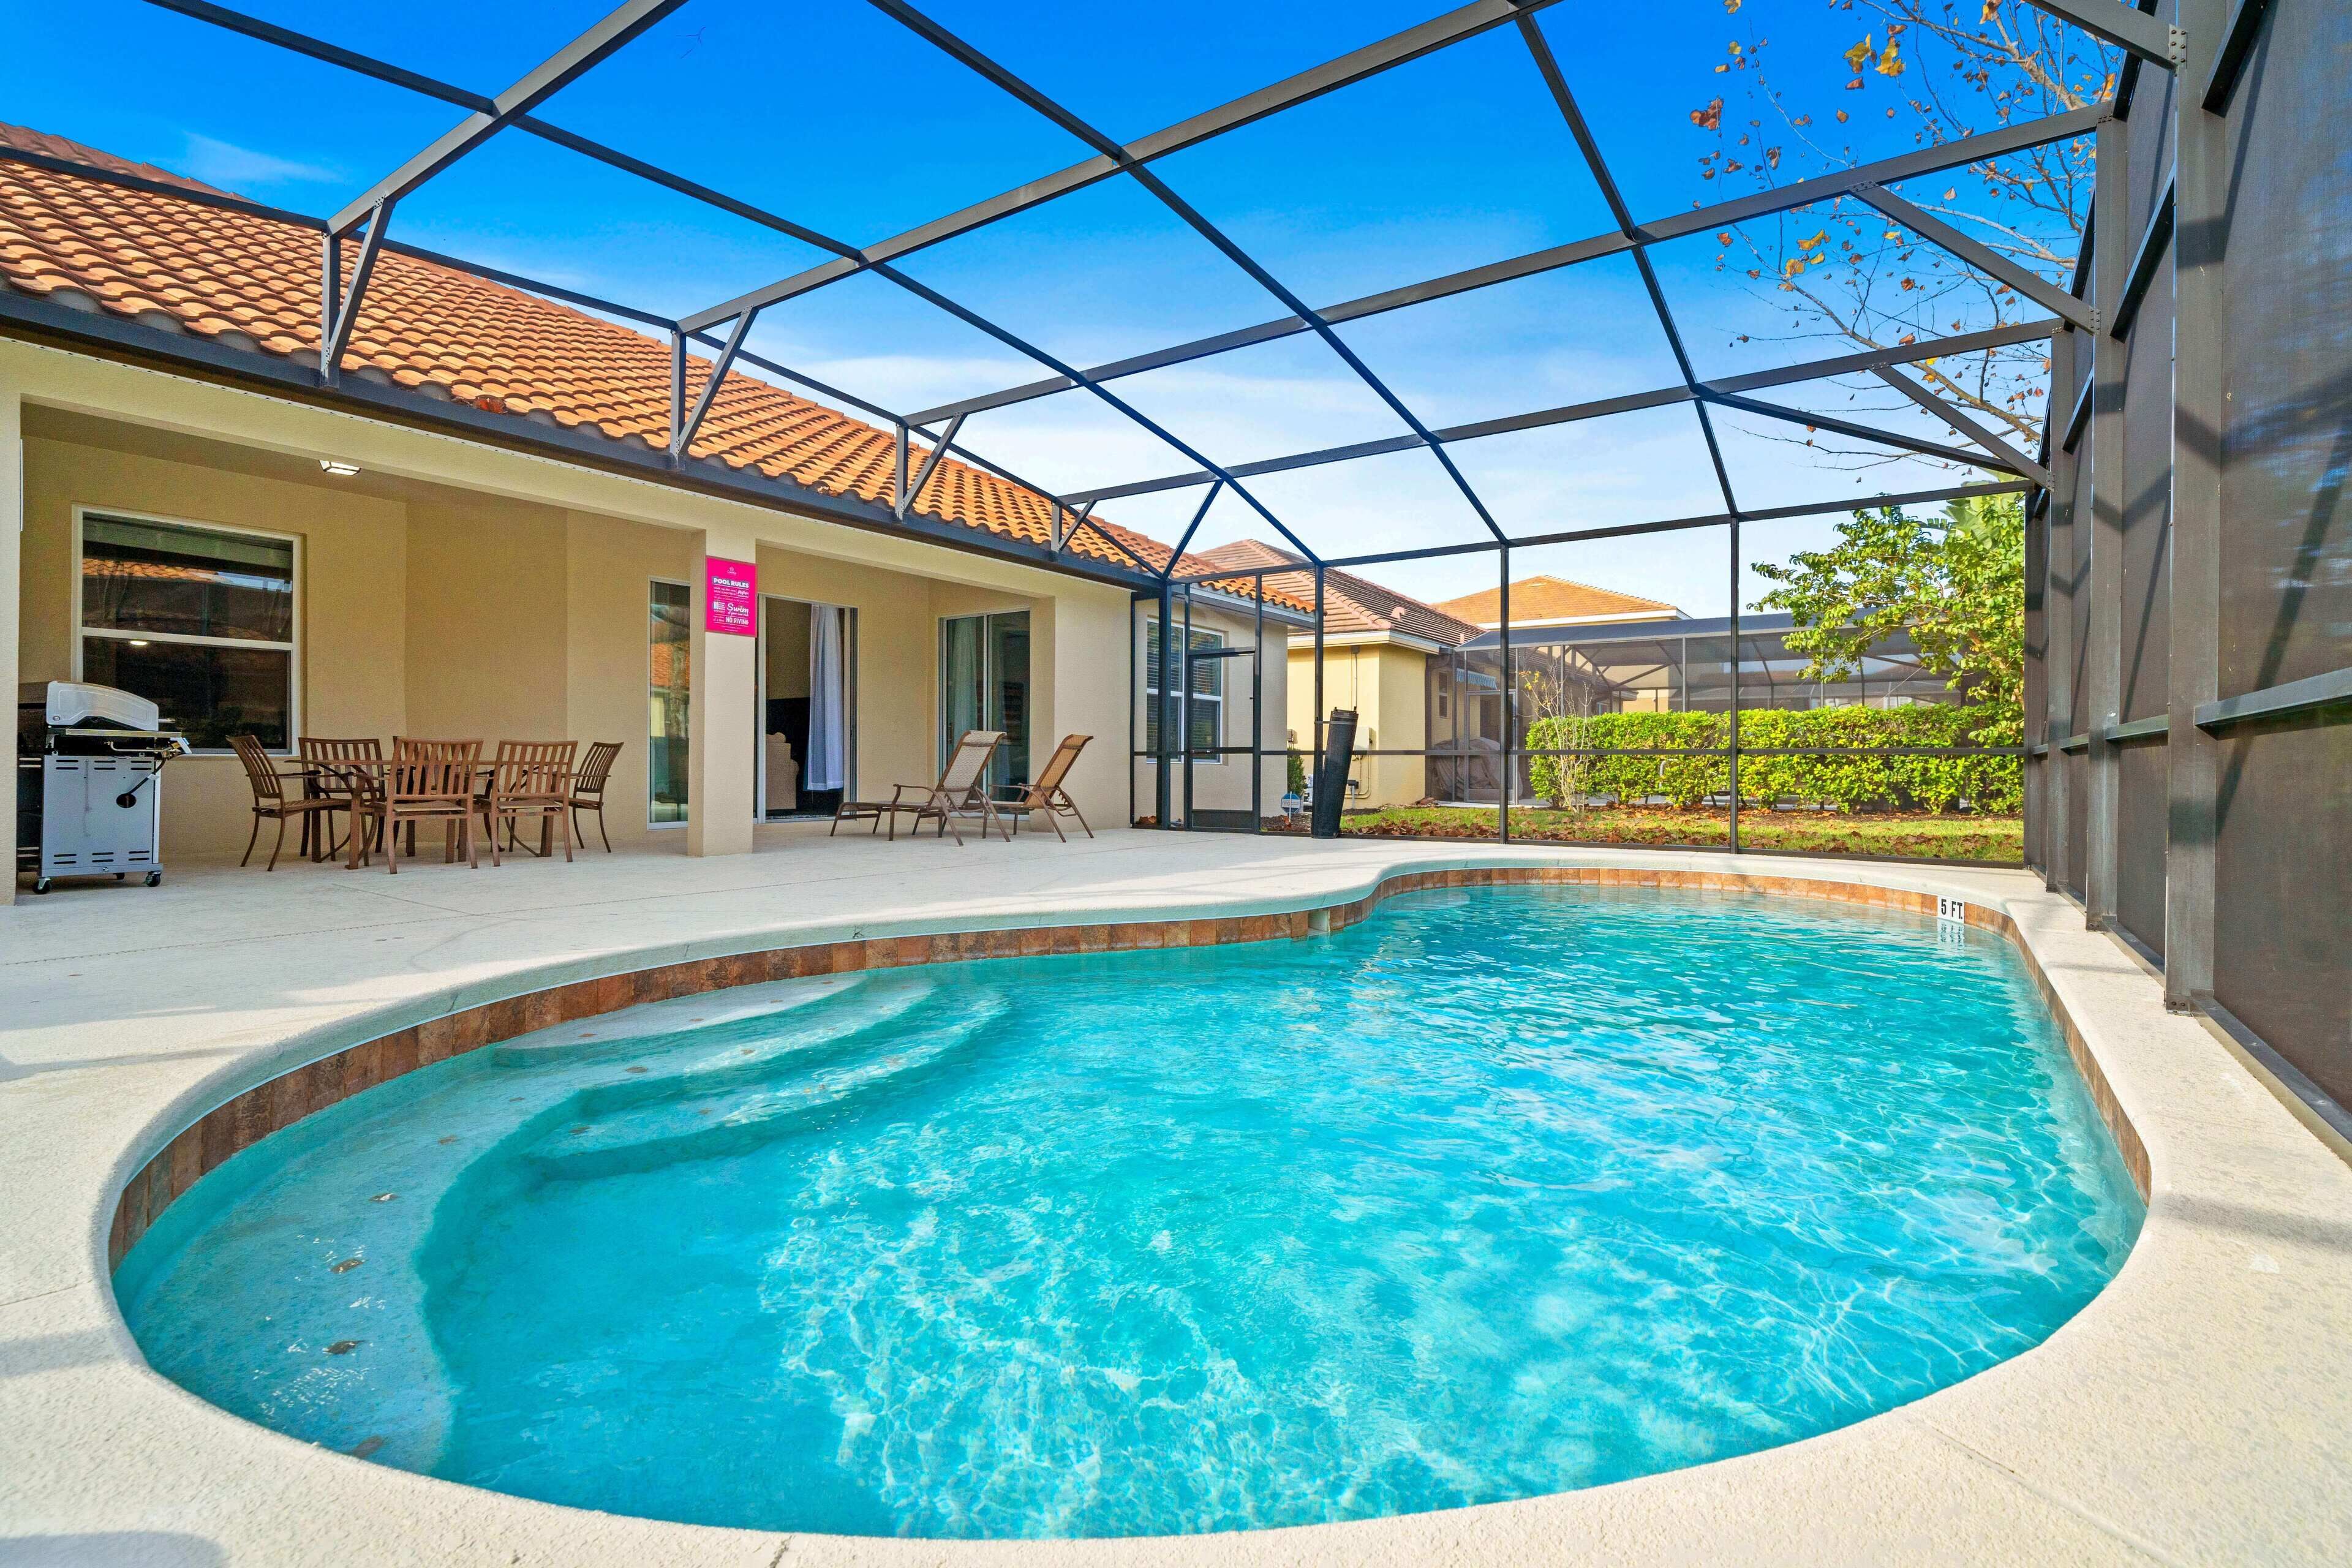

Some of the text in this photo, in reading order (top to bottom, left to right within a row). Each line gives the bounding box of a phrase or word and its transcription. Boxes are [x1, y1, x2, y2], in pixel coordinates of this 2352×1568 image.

[727, 603, 749, 613] Swim
[1941, 899, 1963, 919] 5 FT.
